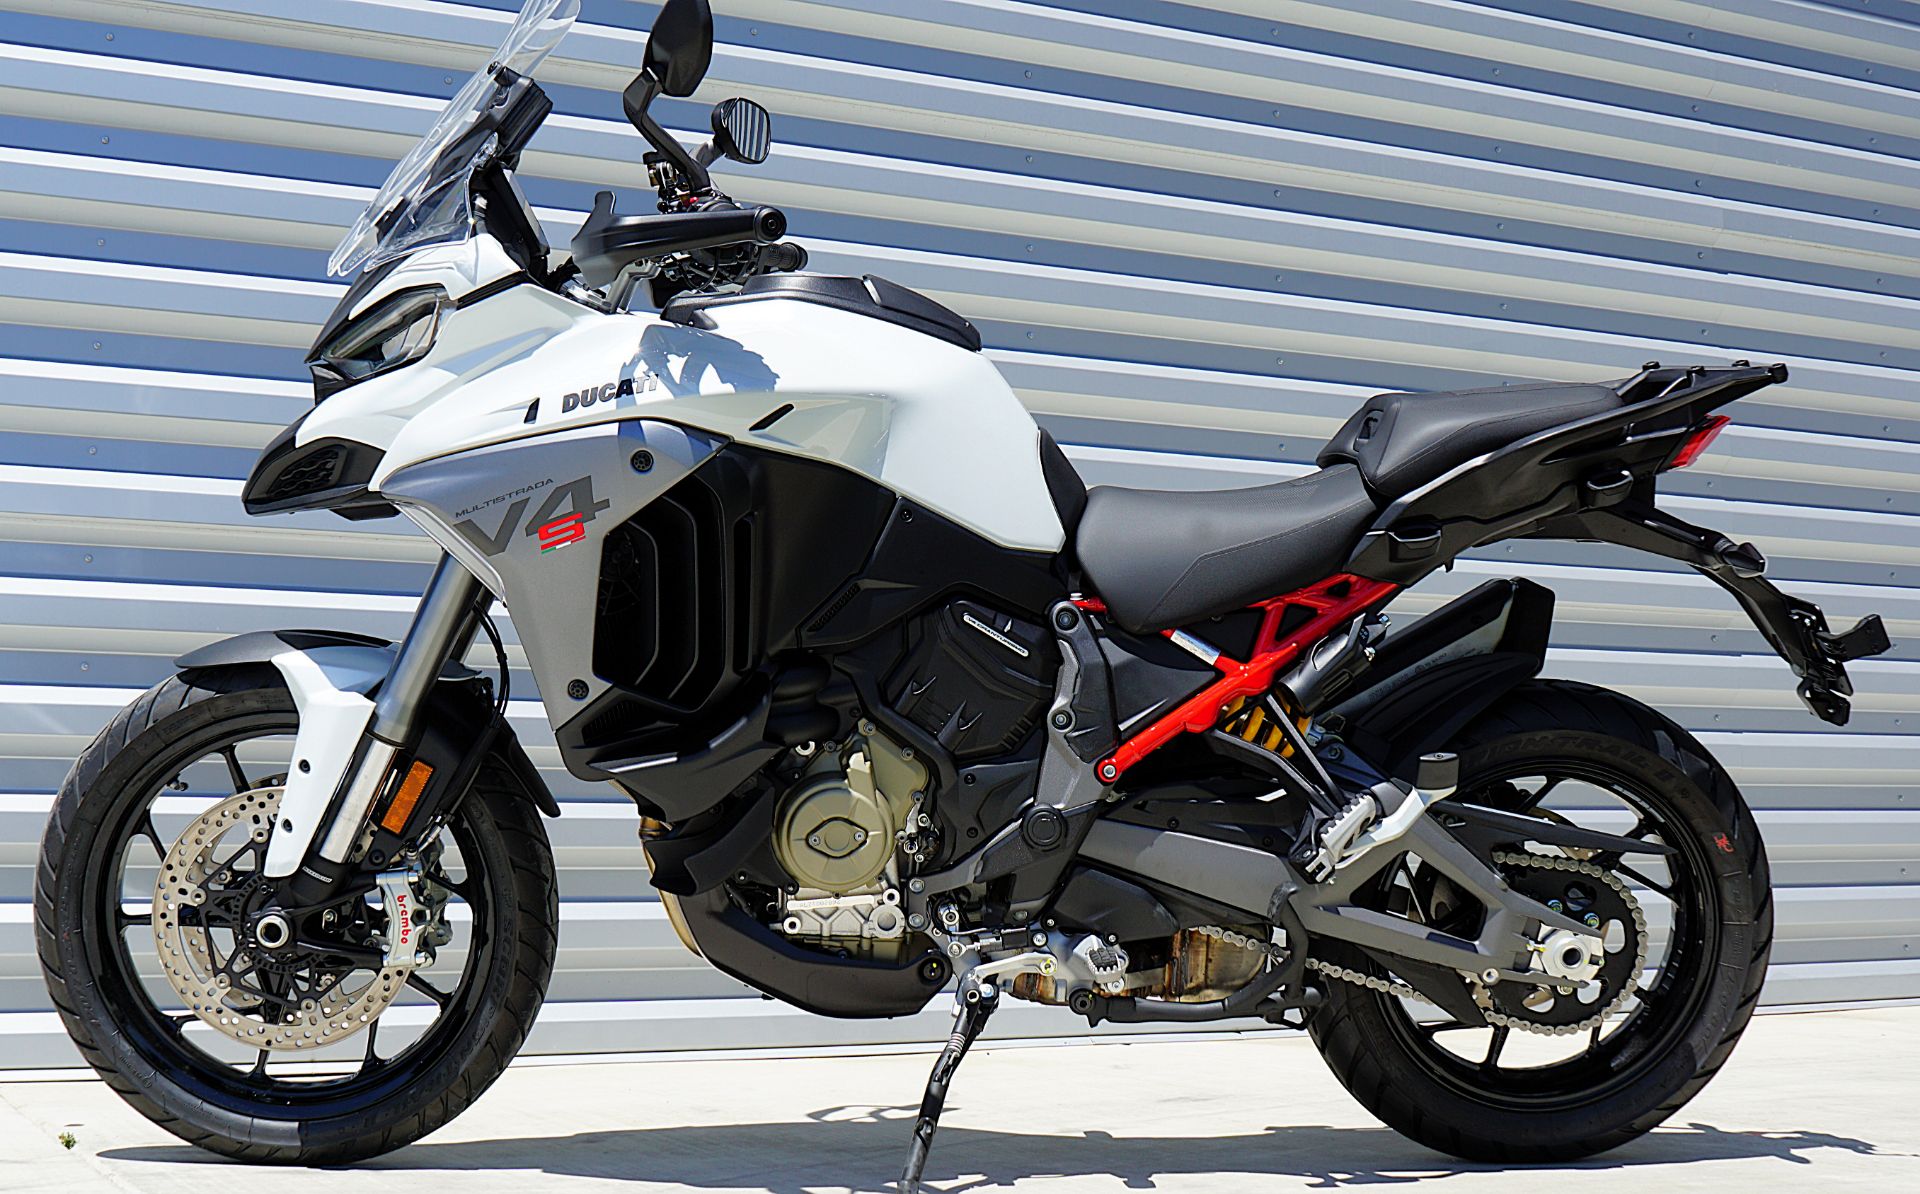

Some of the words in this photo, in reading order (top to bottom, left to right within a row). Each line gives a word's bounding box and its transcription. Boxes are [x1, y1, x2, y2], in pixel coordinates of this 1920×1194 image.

[562, 373, 659, 413] DUCATI
[453, 475, 610, 556] V4
[455, 478, 554, 518] MULTISTRADA
[537, 512, 585, 551] S
[397, 894, 412, 944] brembo
